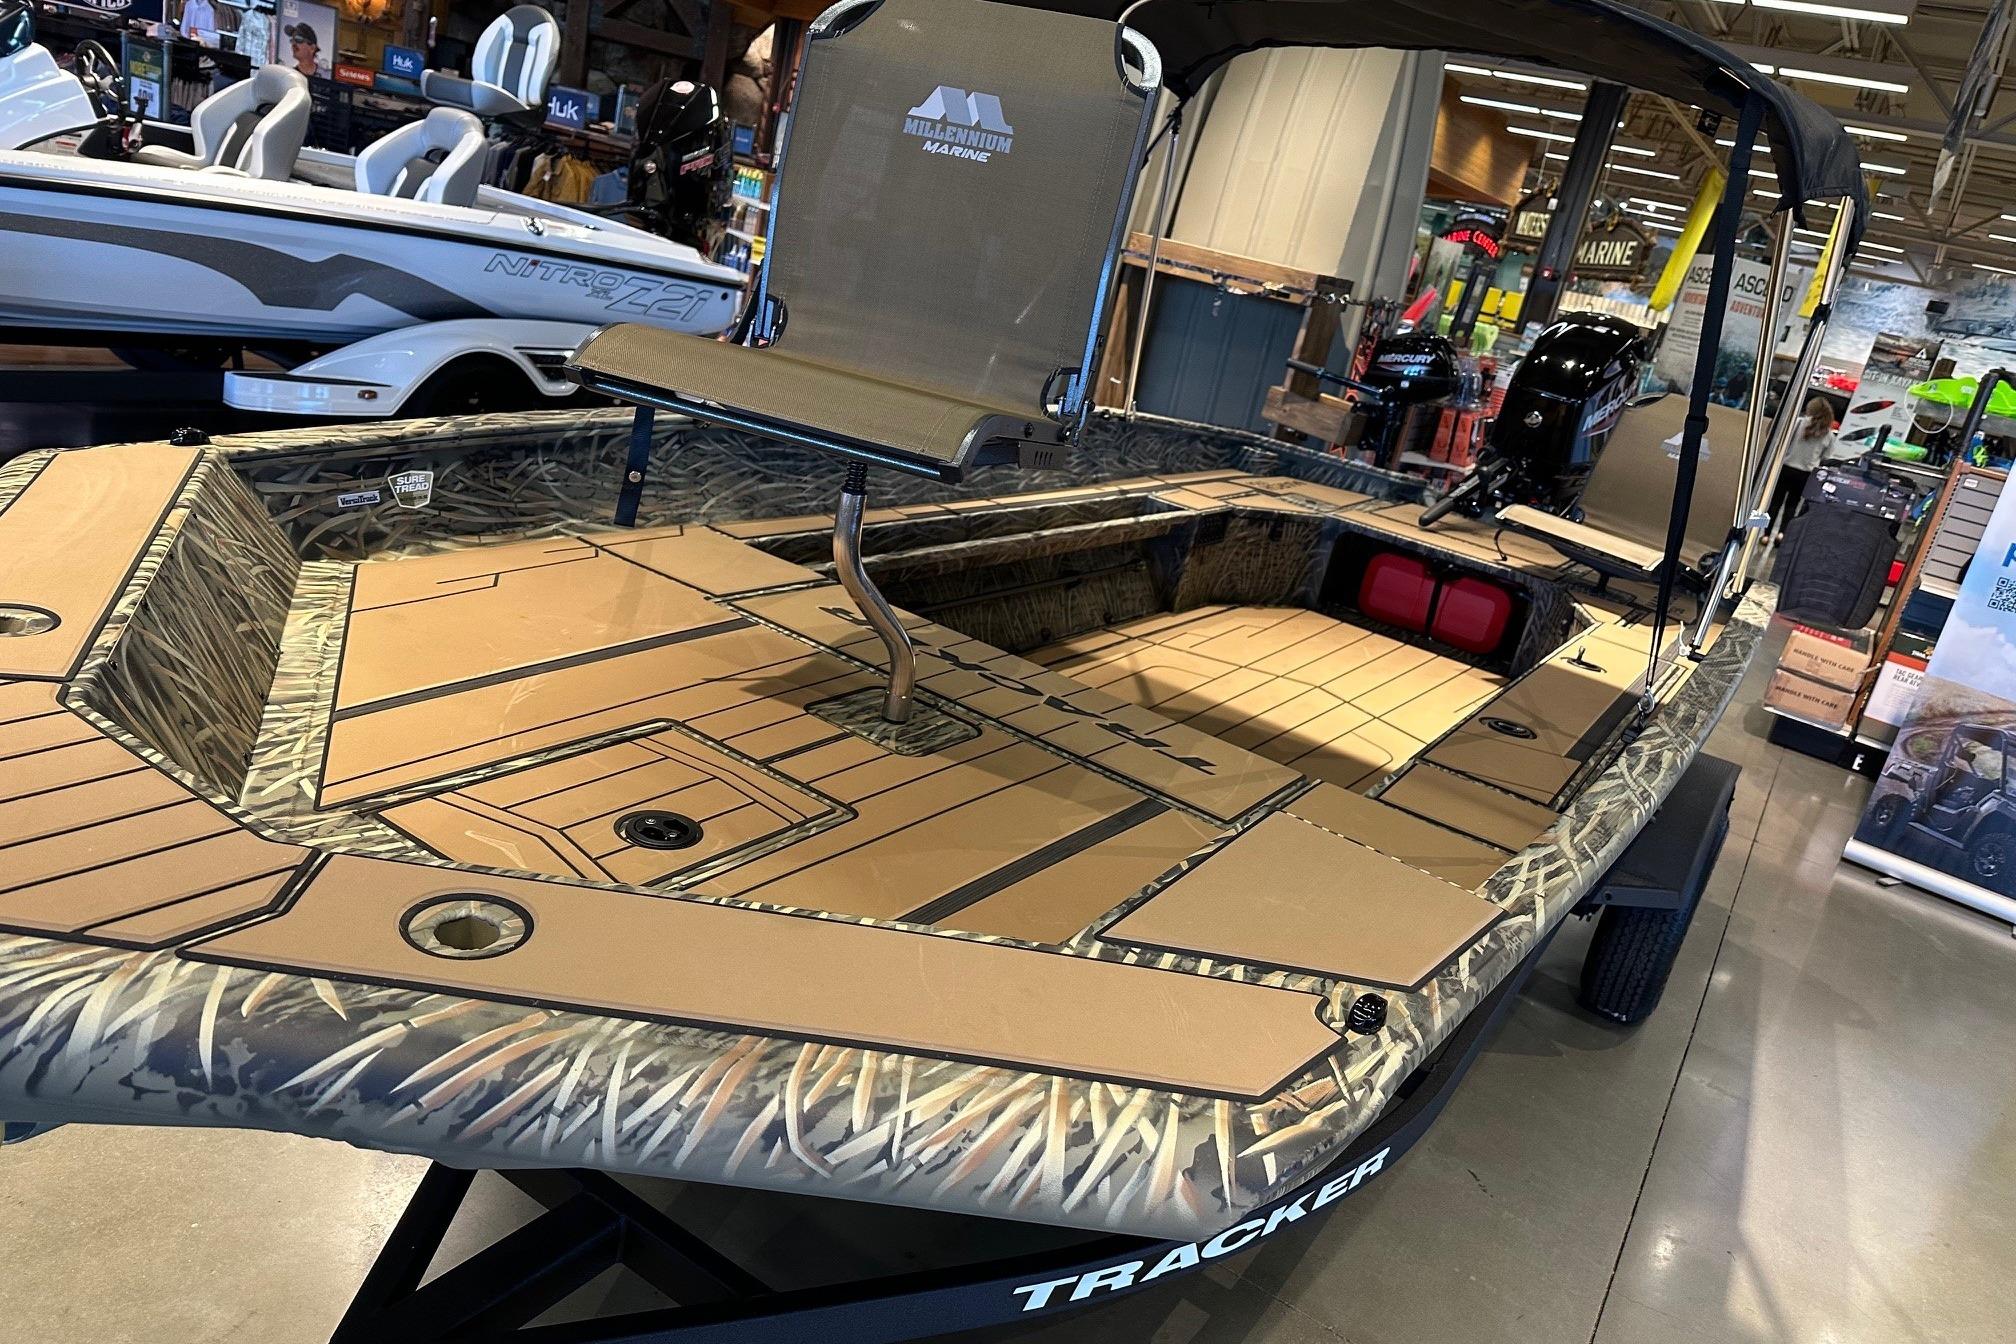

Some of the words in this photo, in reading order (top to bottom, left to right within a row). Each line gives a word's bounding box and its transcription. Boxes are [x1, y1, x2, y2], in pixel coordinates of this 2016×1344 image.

[903, 117, 1013, 154] MILLENNIUM
[922, 140, 992, 163] MARINE
[1734, 273, 1794, 303] ASCD
[1377, 353, 1436, 364] MERCURY
[394, 482, 430, 493] TREAD
[396, 474, 426, 485] SURE
[339, 493, 379, 506] VersaTrack
[1793, 647, 1819, 661] HANDLE
[1820, 657, 1837, 668] WITH
[1838, 663, 1855, 673] CARE
[818, 605, 1217, 776] TRACKR
[1775, 685, 1802, 698] HANDLE
[1802, 693, 1821, 704] WITH
[1821, 699, 1838, 710] CARE
[1852, 753, 1865, 771] E
[1013, 1146, 1392, 1312] TRACKER
